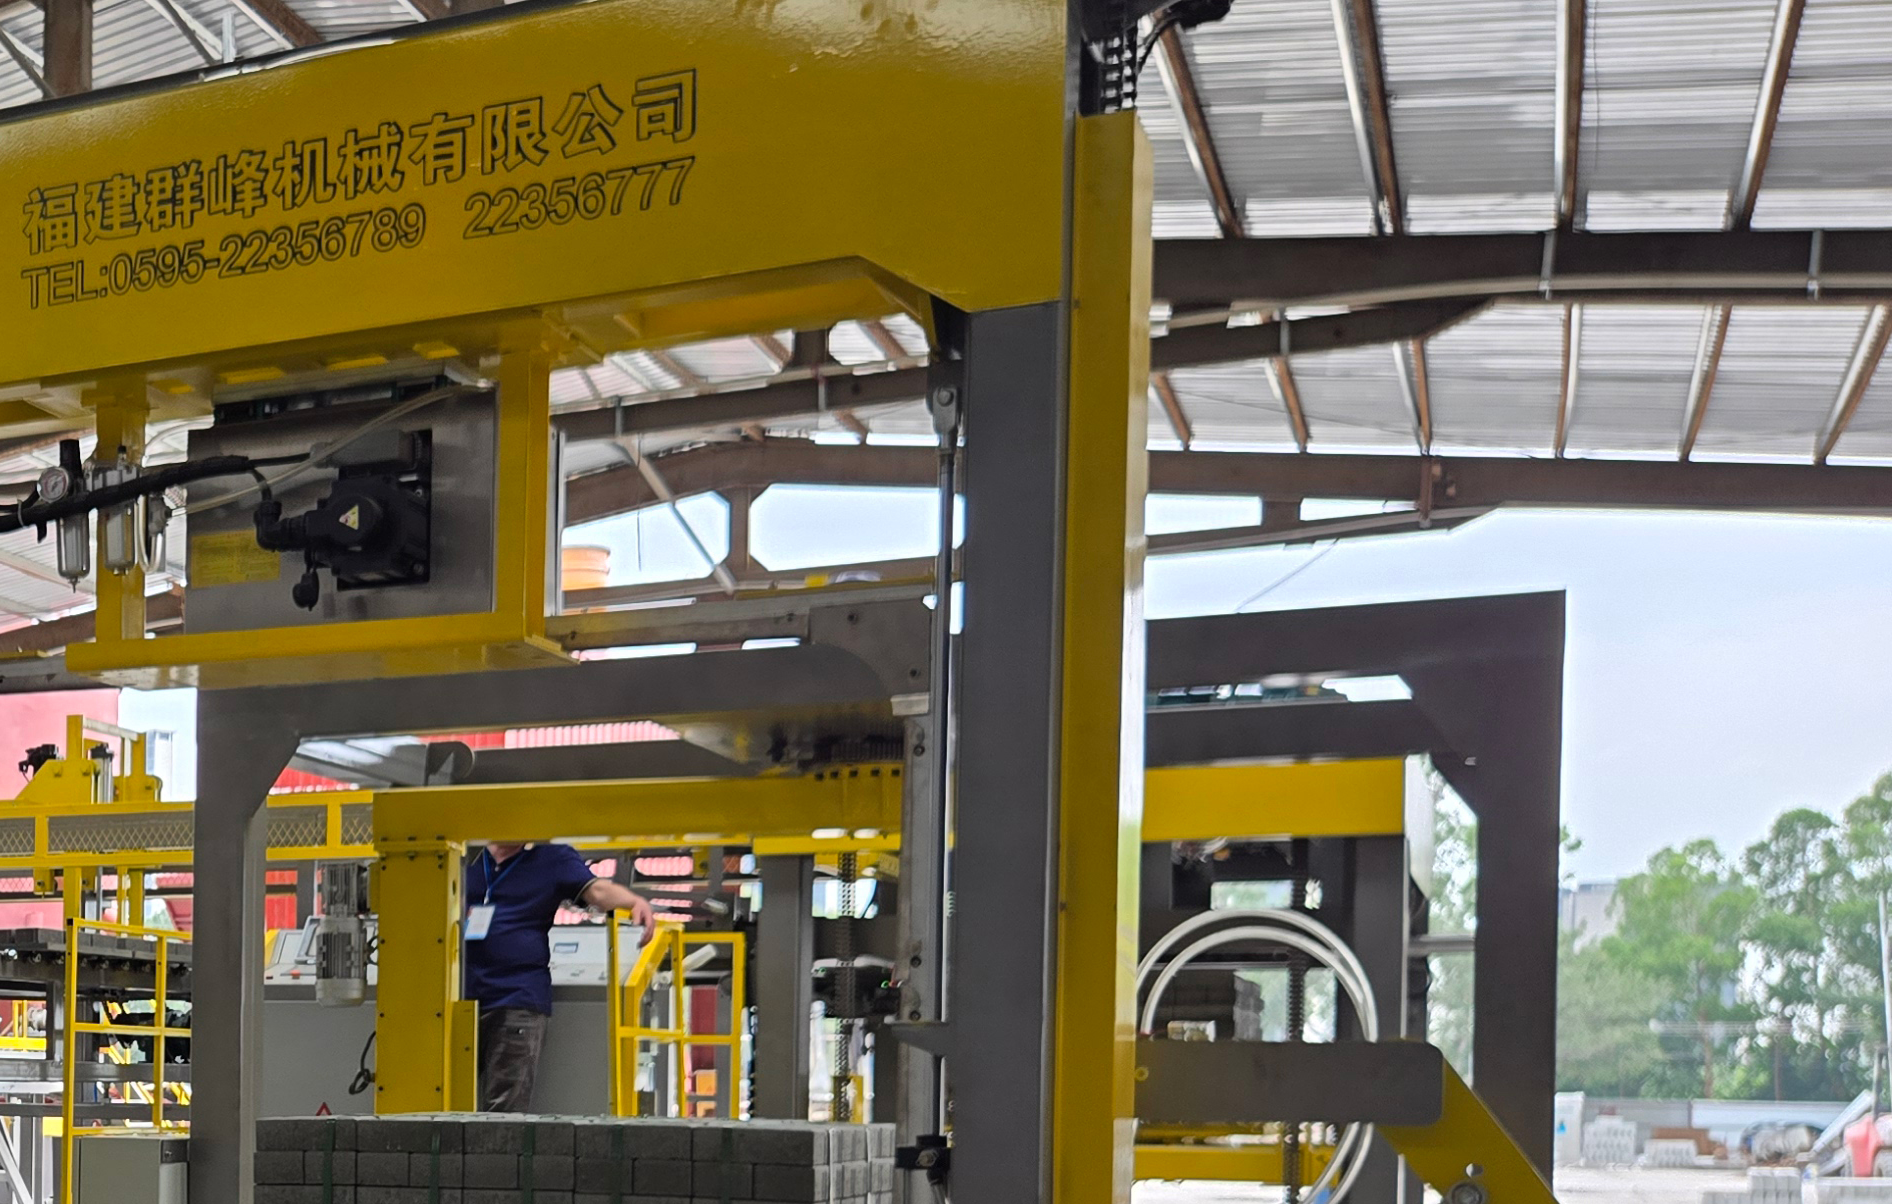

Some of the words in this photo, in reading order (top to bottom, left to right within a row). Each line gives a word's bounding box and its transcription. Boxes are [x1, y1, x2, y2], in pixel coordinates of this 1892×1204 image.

[20, 202, 426, 310] TEL:0595-22356789
[462, 155, 695, 240] 22356777
[22, 68, 696, 255] 福建群峰机械有限公司
